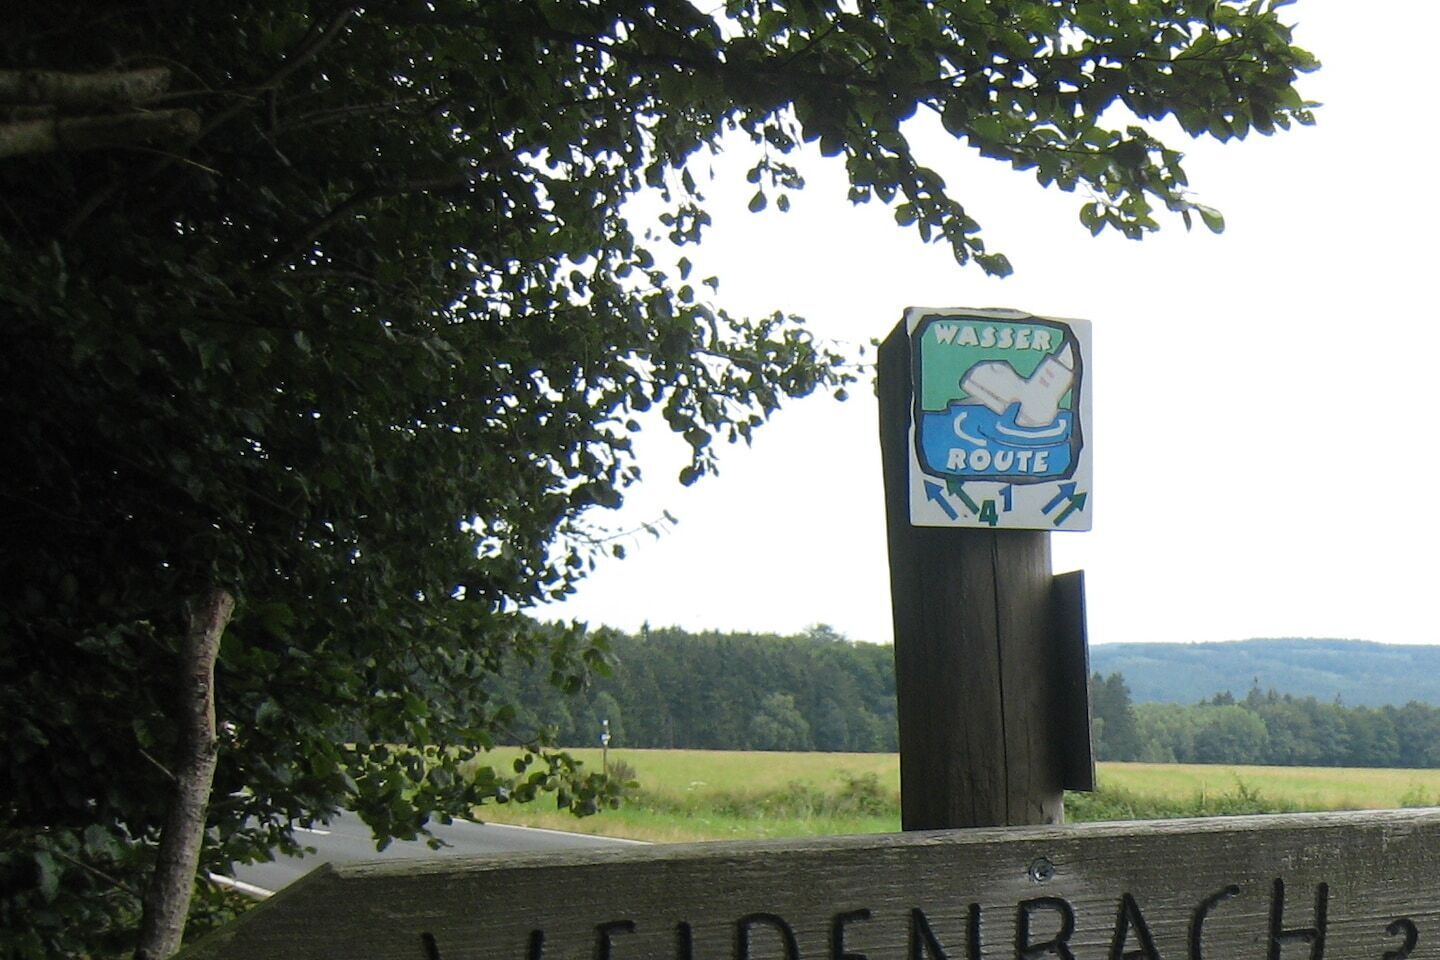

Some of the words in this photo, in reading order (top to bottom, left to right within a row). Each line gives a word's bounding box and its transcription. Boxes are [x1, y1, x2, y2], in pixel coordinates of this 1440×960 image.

[934, 323, 1052, 351] WASSER
[946, 448, 1049, 474] ROUTE
[999, 484, 1012, 512] 1
[978, 500, 999, 526] 4
